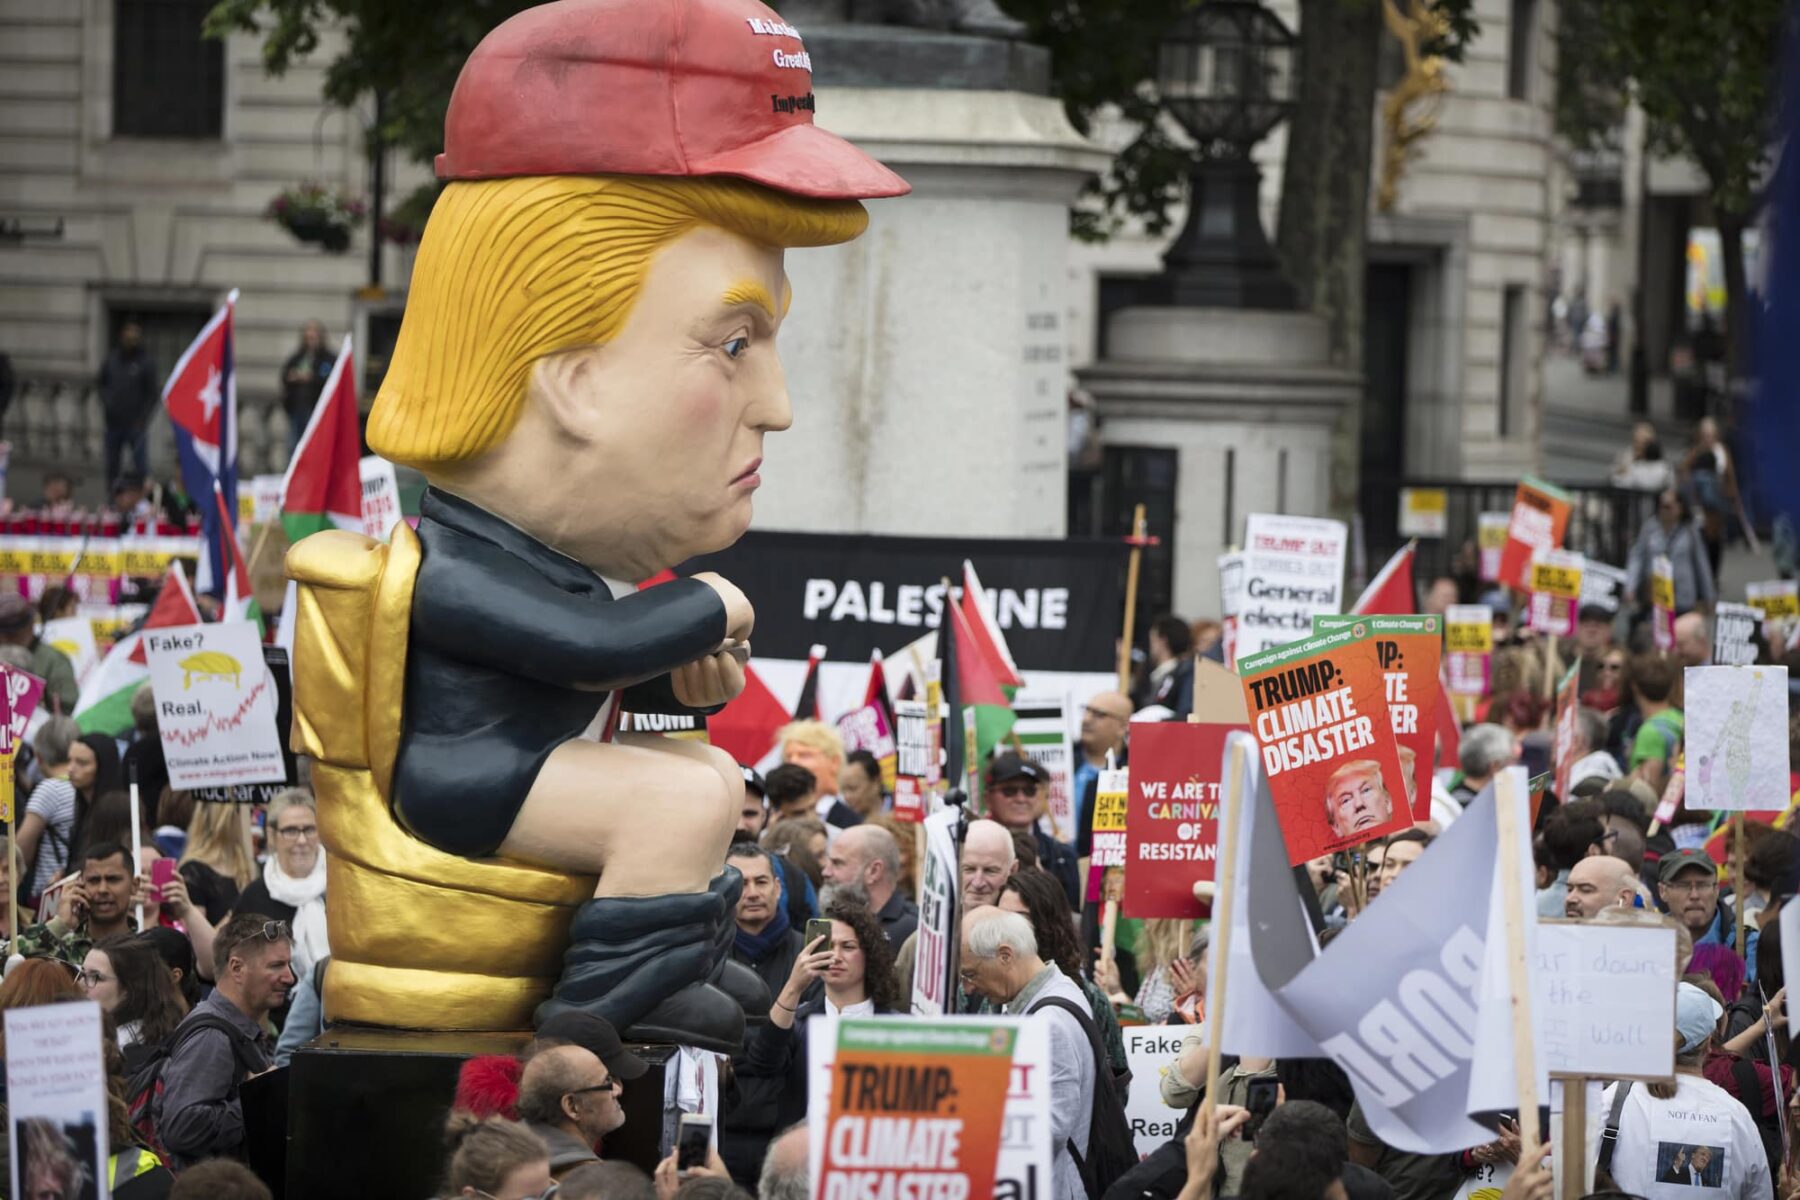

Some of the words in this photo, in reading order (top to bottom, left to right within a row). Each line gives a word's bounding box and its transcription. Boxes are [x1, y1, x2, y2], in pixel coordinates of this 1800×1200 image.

[1248, 577, 1336, 604] General
[1245, 606, 1312, 629] electi
[150, 632, 204, 651] Fake?
[1245, 652, 1277, 670] Campaign
[1278, 645, 1303, 660] against
[1303, 637, 1327, 652] Climate
[1327, 630, 1352, 644] Change
[1249, 659, 1344, 710] TRUMP:
[1257, 686, 1357, 743] CLIMATE
[1262, 716, 1375, 777] DISASTER
[1140, 782, 1167, 799] WE
[1171, 783, 1204, 800] ARE
[1177, 823, 1202, 840] OF
[1139, 843, 1220, 861] RESISTAN
[1592, 944, 1659, 976] down
[1548, 979, 1593, 1004] the
[841, 1064, 959, 1113] TRUMP:
[1668, 1110, 1687, 1120] NOT
[1690, 1112, 1697, 1121] A
[1698, 1114, 1718, 1123] FAN
[829, 1115, 964, 1171] CLIMATE
[823, 1171, 971, 1200] DISASTER
